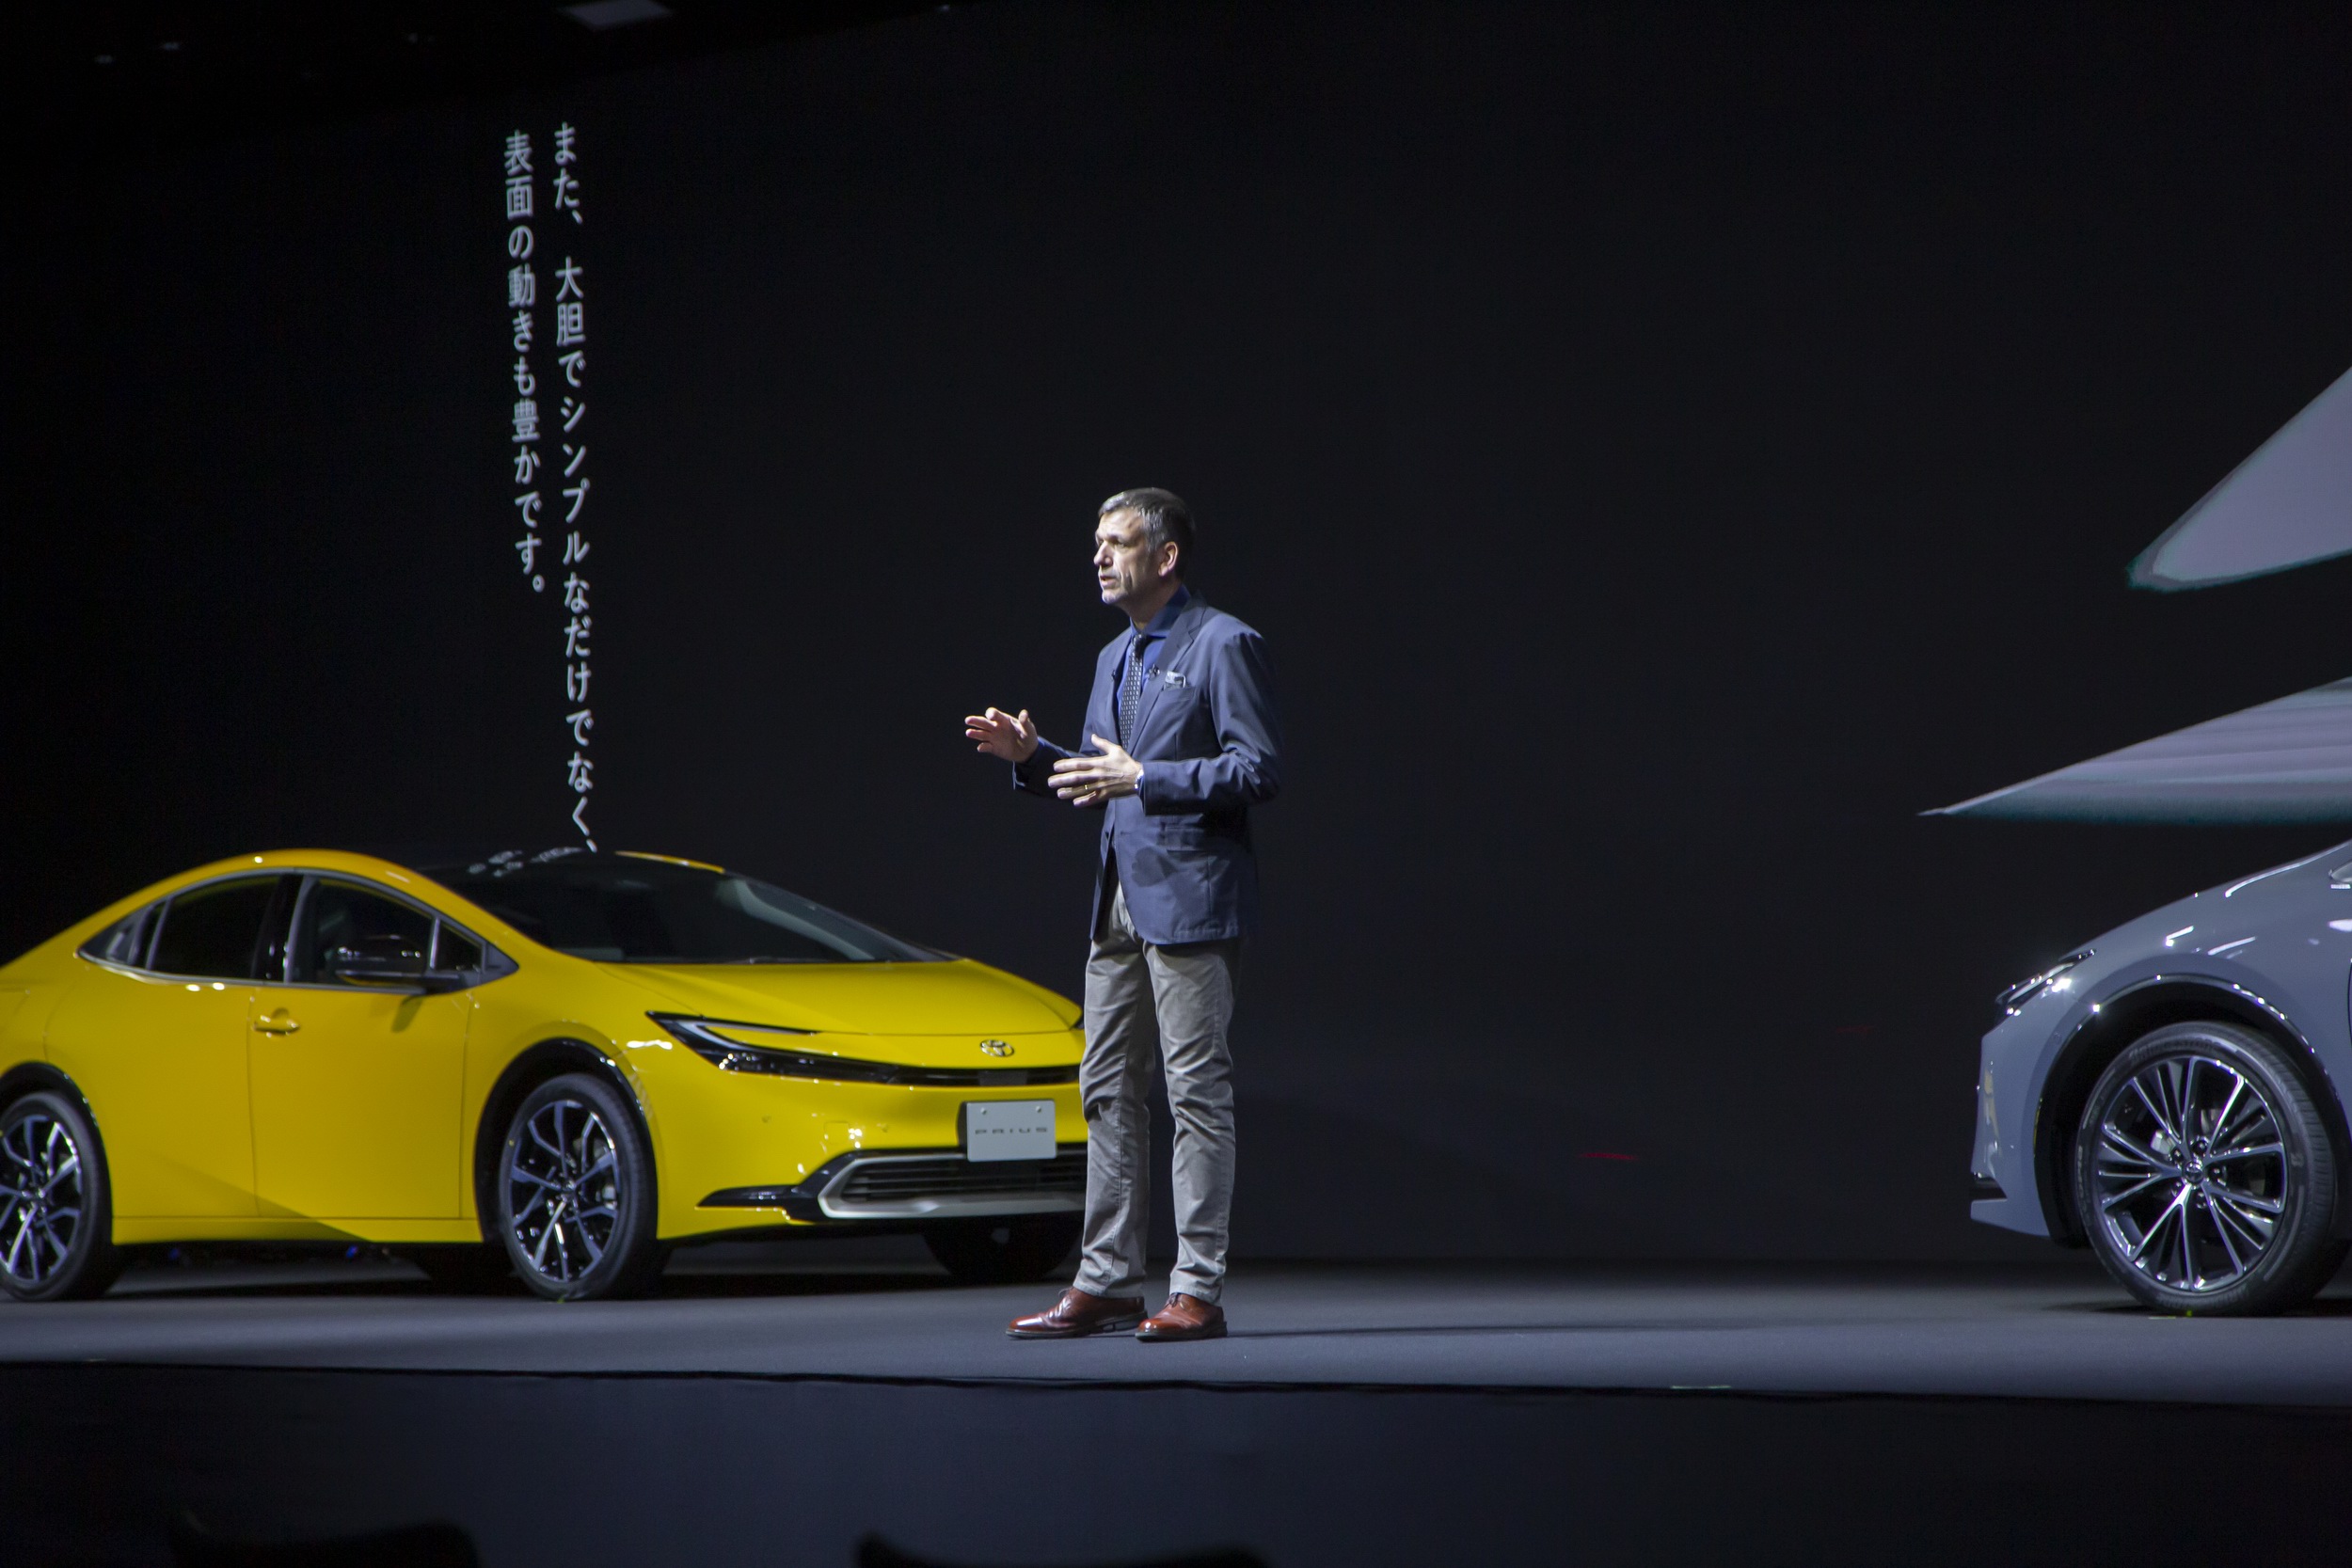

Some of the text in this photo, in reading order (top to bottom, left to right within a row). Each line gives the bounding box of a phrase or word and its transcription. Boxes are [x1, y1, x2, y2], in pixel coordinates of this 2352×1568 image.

[504, 130, 545, 593] 表面の動きも豊かです。
